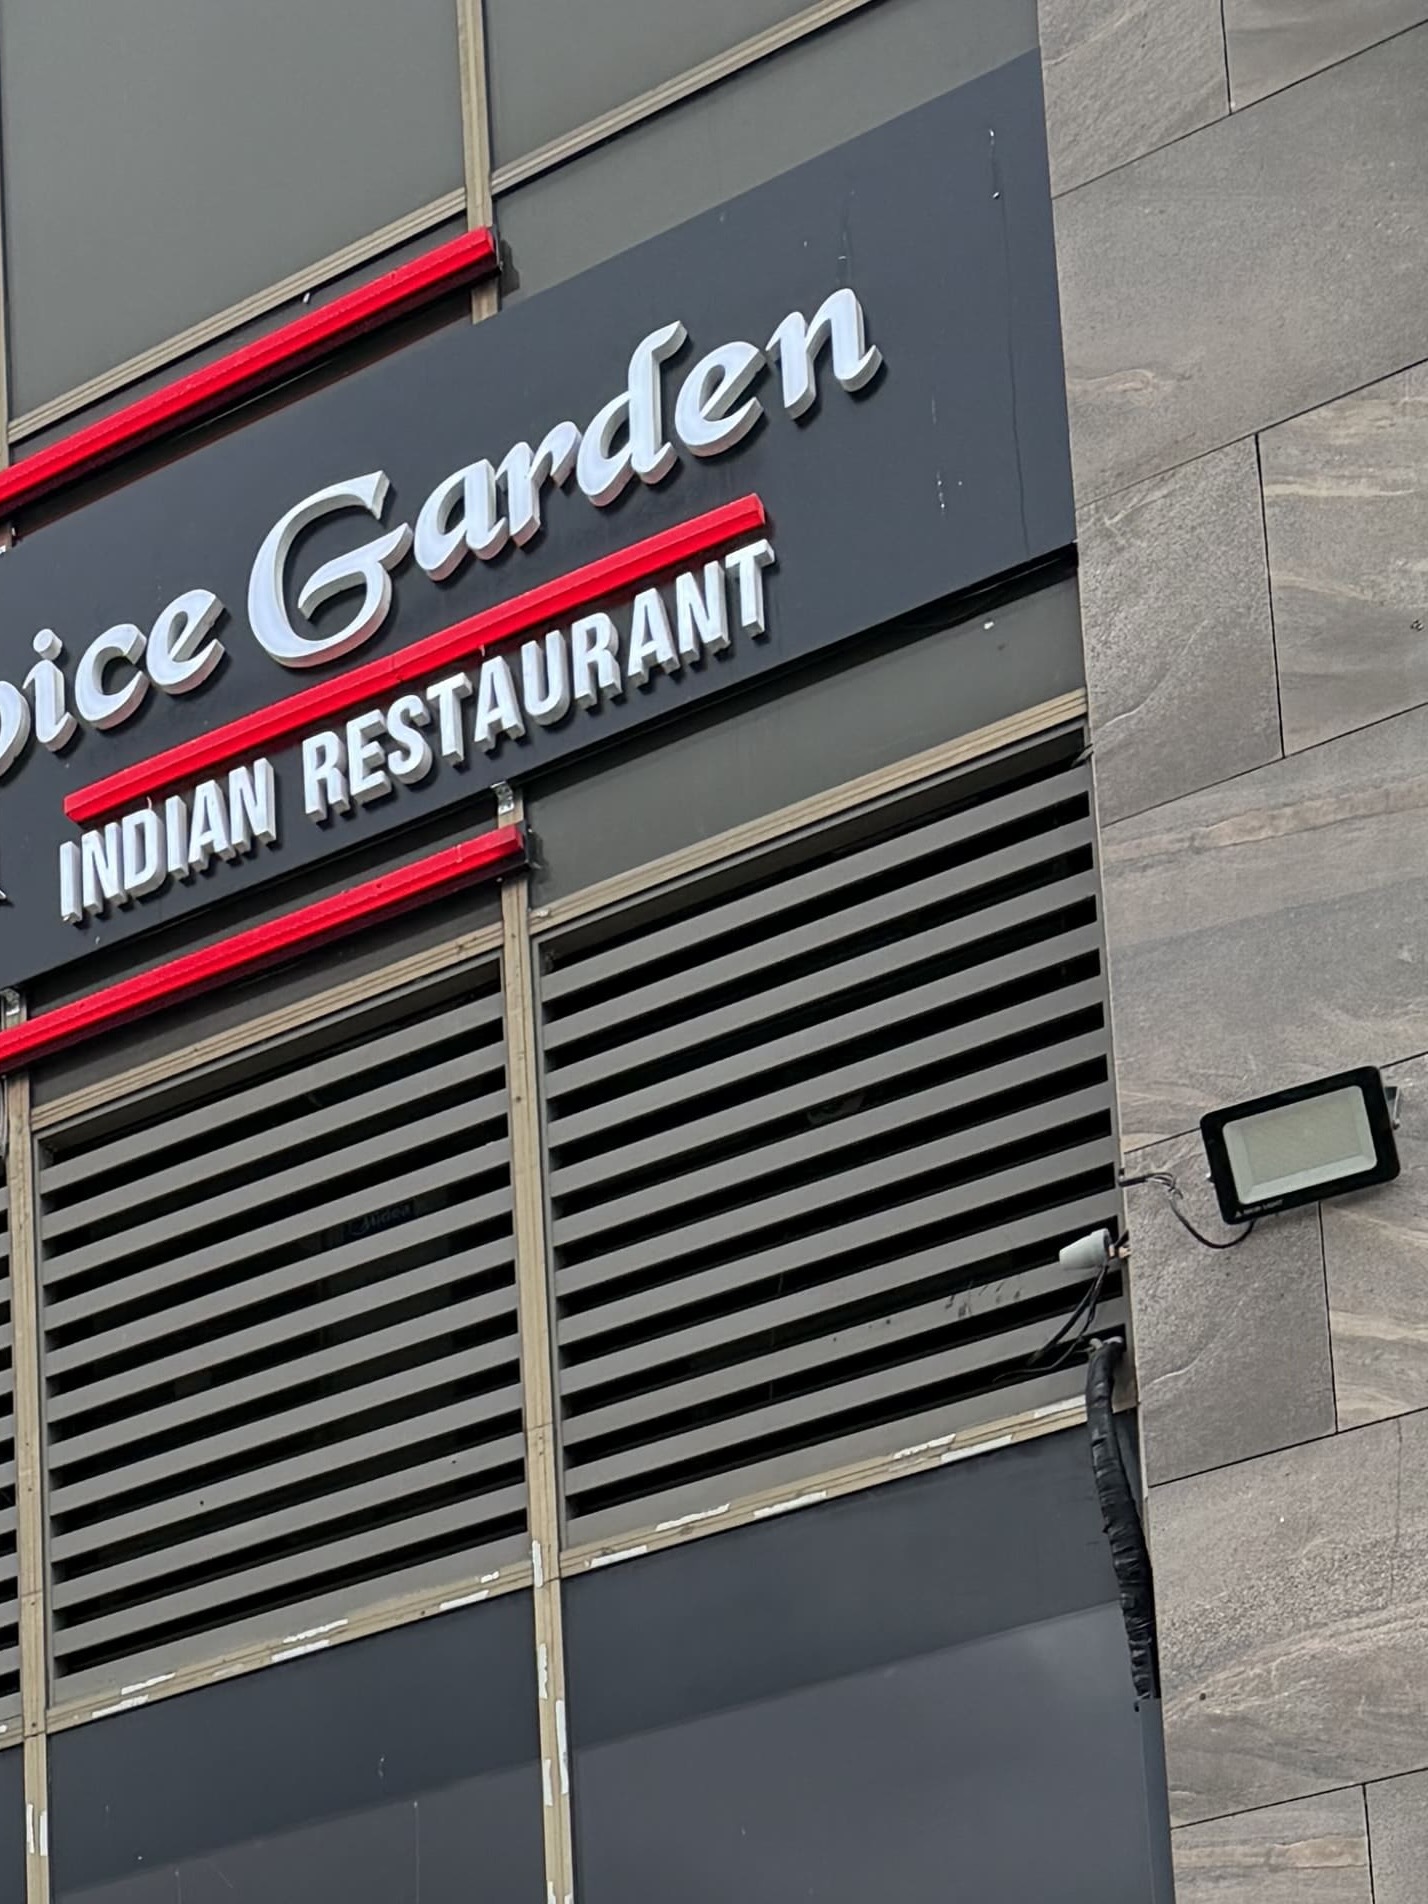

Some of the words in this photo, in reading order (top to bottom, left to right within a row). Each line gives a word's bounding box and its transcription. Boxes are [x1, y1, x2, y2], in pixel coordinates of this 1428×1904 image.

[247, 285, 884, 669] Garden
[58, 756, 277, 924] INDIAN
[303, 538, 777, 824] RESTAURANT
